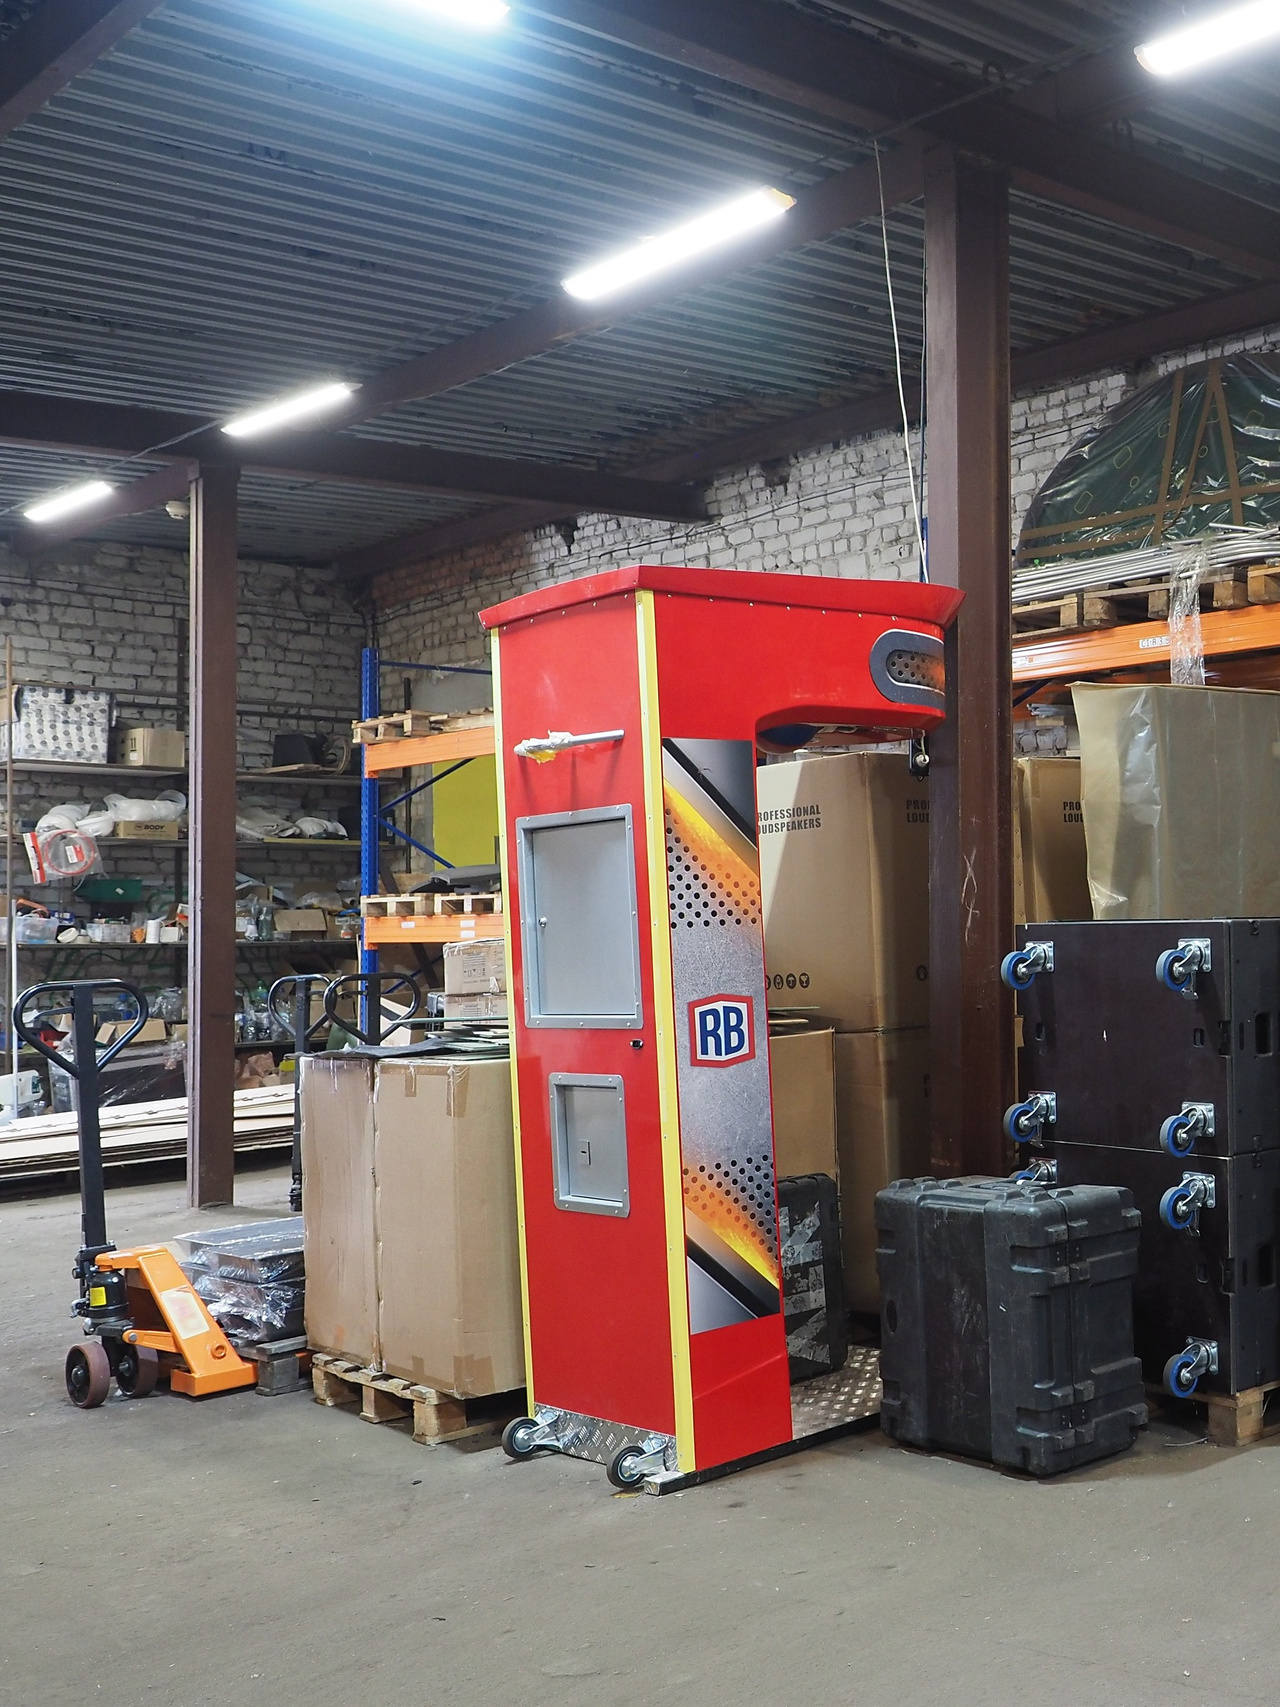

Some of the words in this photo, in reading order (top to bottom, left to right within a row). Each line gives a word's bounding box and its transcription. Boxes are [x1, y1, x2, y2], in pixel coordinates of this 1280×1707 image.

[757, 804, 821, 822] ROFESSIONAL
[757, 818, 822, 835] OUDSPEAKERS
[698, 1005, 745, 1057] RB
